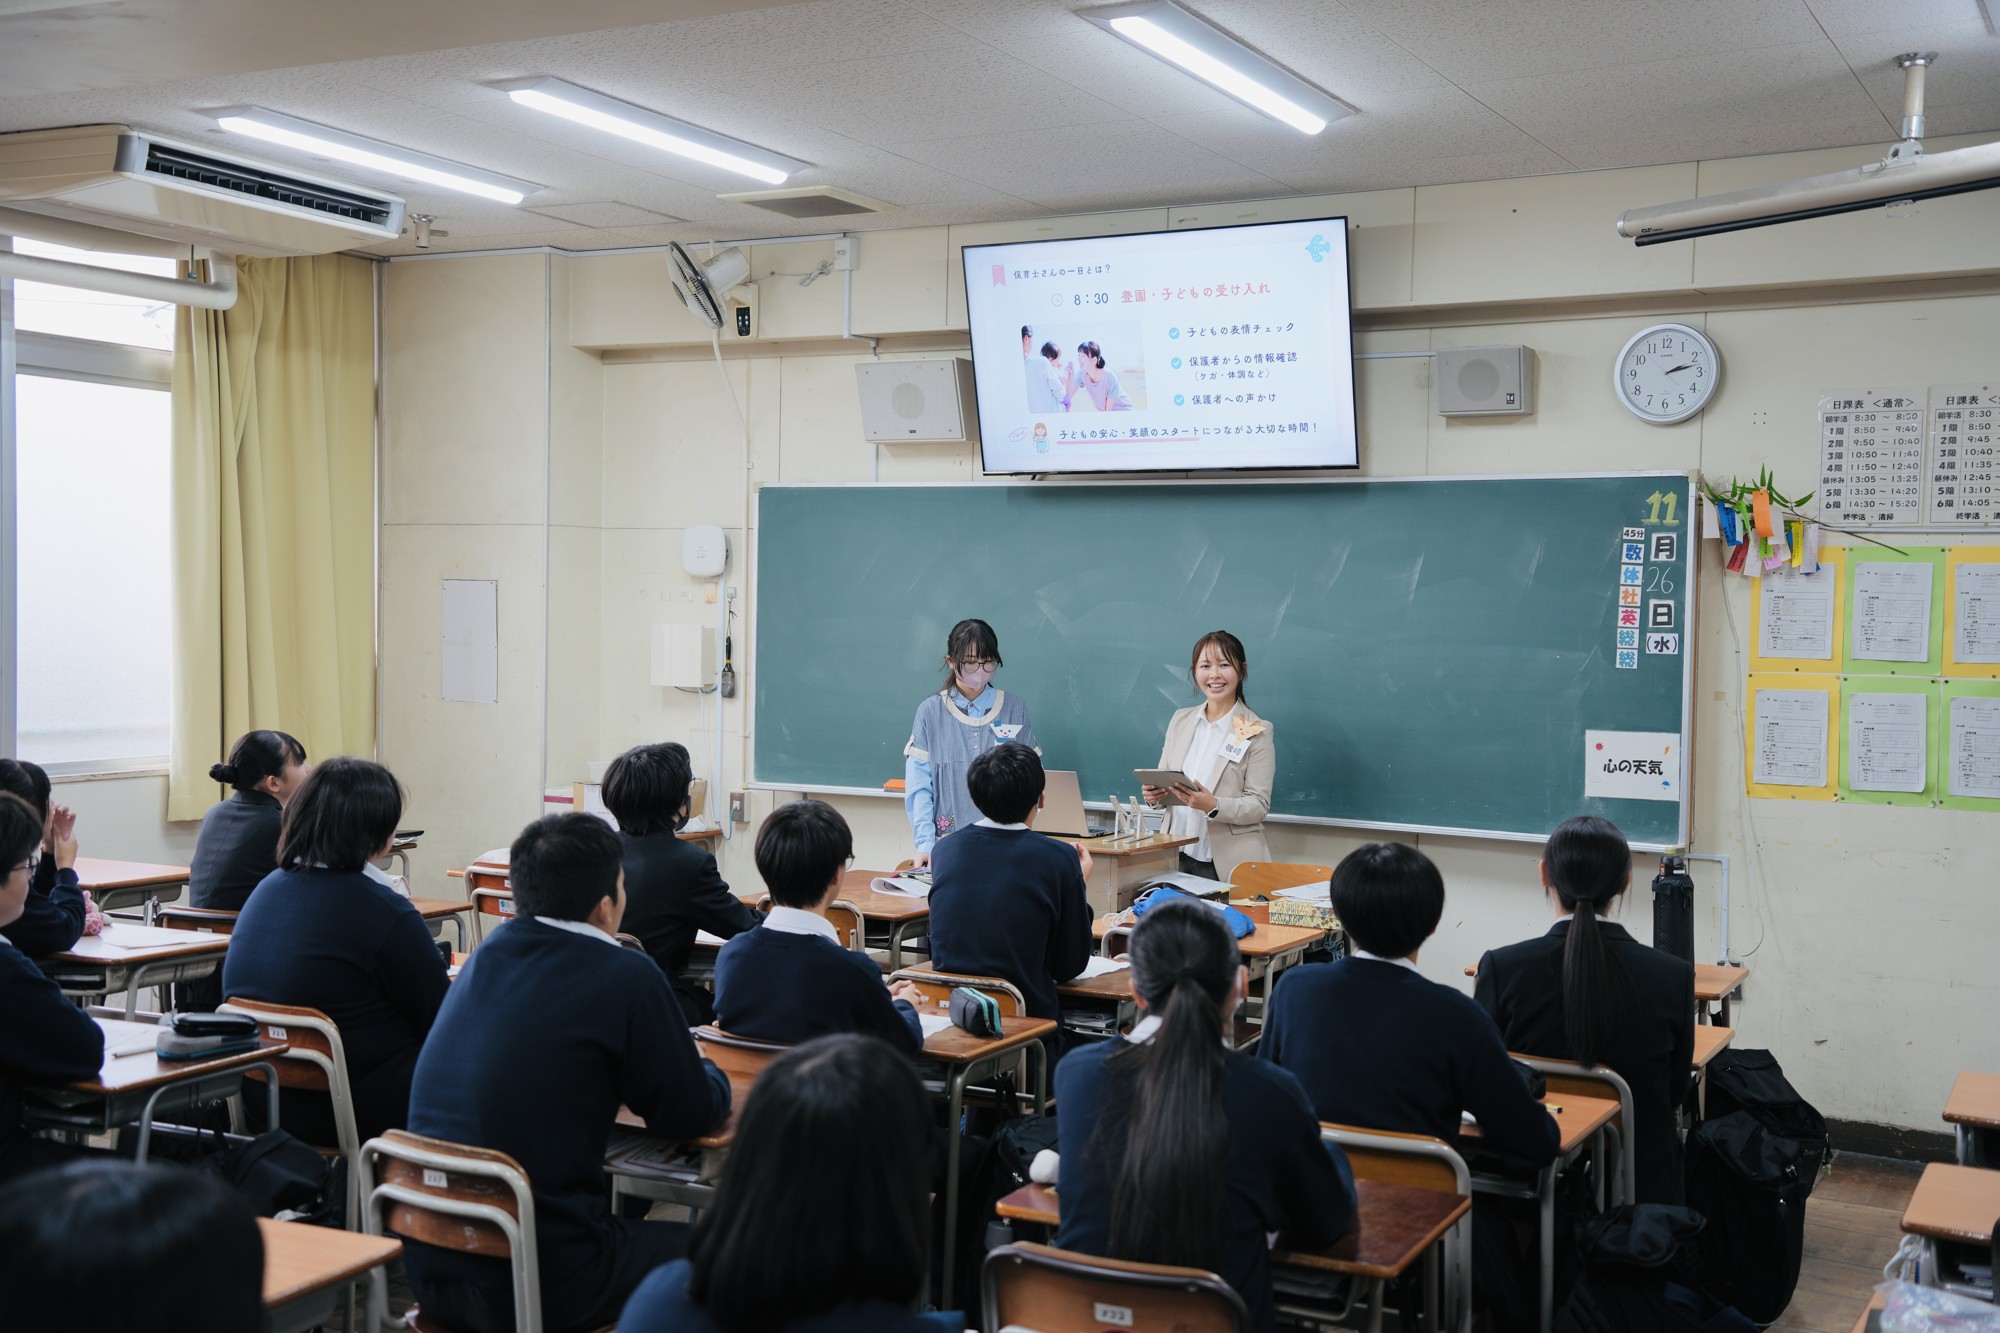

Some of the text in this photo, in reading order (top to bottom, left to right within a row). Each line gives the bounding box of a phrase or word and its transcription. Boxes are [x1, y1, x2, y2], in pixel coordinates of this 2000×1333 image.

[1013, 263, 1111, 280] 保育士さんの一日とは？
[1120, 281, 1271, 304] 登園・子どもの受け入れ
[1187, 322, 1294, 338] 子どもの表情チェック
[1647, 343, 1657, 354] 11
[1662, 338, 1672, 349] 12
[1681, 341, 1685, 353] 1
[1188, 351, 1298, 367] 保護者からの情報確認
[1635, 355, 1646, 365] 10
[1691, 351, 1698, 363] 2
[1194, 368, 1270, 382] （ケガ・体調など）
[1630, 369, 1637, 380] 9
[1696, 366, 1703, 378] 3
[1634, 385, 1641, 396] 8
[1689, 382, 1697, 393] 4
[1191, 392, 1277, 406] 保護者への声かけ
[1647, 395, 1654, 406] 7
[1662, 398, 1669, 409] 6
[1678, 394, 1685, 405] 5
[1833, 399, 1864, 410] 日課表
[1945, 395, 1979, 405] 日課表
[1825, 415, 1848, 423] 朝学活
[1854, 413, 1876, 422] 8:30
[1937, 410, 1992, 419] 朝学活 8:30
[1829, 427, 1844, 435] 1限
[1854, 426, 1876, 434] 8:50
[1896, 425, 1917, 433] 9:40
[1942, 423, 1991, 432] 1限 8:50
[1828, 439, 1844, 448] 2限
[1853, 438, 1875, 446] 9:50
[1893, 437, 1920, 445] 10:40
[1940, 435, 1990, 445] 2限 9:45
[1827, 451, 1843, 460] 3限
[1850, 450, 1878, 459] 10:50
[1892, 450, 1919, 458] 11:40
[1940, 448, 1993, 457] 3限 10:40
[1826, 463, 1843, 472] 4限
[1850, 462, 1877, 471] 11:50
[1892, 462, 1919, 470] 12:40
[1938, 462, 1956, 470] 4限
[1964, 461, 1992, 469] 11:35
[1823, 476, 1845, 484] 昼休み
[1850, 475, 1876, 483] 13:05
[1891, 475, 1918, 483] 13:25
[1934, 474, 1958, 482] 昼休み
[1964, 473, 1991, 481] 12:45
[1826, 488, 1842, 497] 5限
[1849, 488, 1876, 496] 13:30
[1890, 487, 1918, 495] 14:20
[1937, 486, 1955, 495] 5限
[1963, 486, 1991, 494] 13:10
[1641, 490, 1679, 526] 11
[1825, 500, 1841, 509] 6限
[1849, 500, 1875, 508] 14:30
[1890, 499, 1917, 508] 15:20
[1937, 499, 1954, 508] 6限
[1962, 499, 1990, 507] 14:05
[1624, 530, 1644, 538] 45分
[1625, 544, 1642, 560] 数
[1654, 536, 1675, 559] 月
[1623, 567, 1639, 583] 体
[1646, 567, 1674, 594] 26
[1621, 588, 1638, 604] 社
[1620, 609, 1637, 625] 英
[1652, 604, 1673, 626] 日
[1619, 630, 1635, 646] 総
[1646, 636, 1677, 653] (水)
[1618, 651, 1635, 667] 総
[1603, 758, 1664, 775] 心の天気
